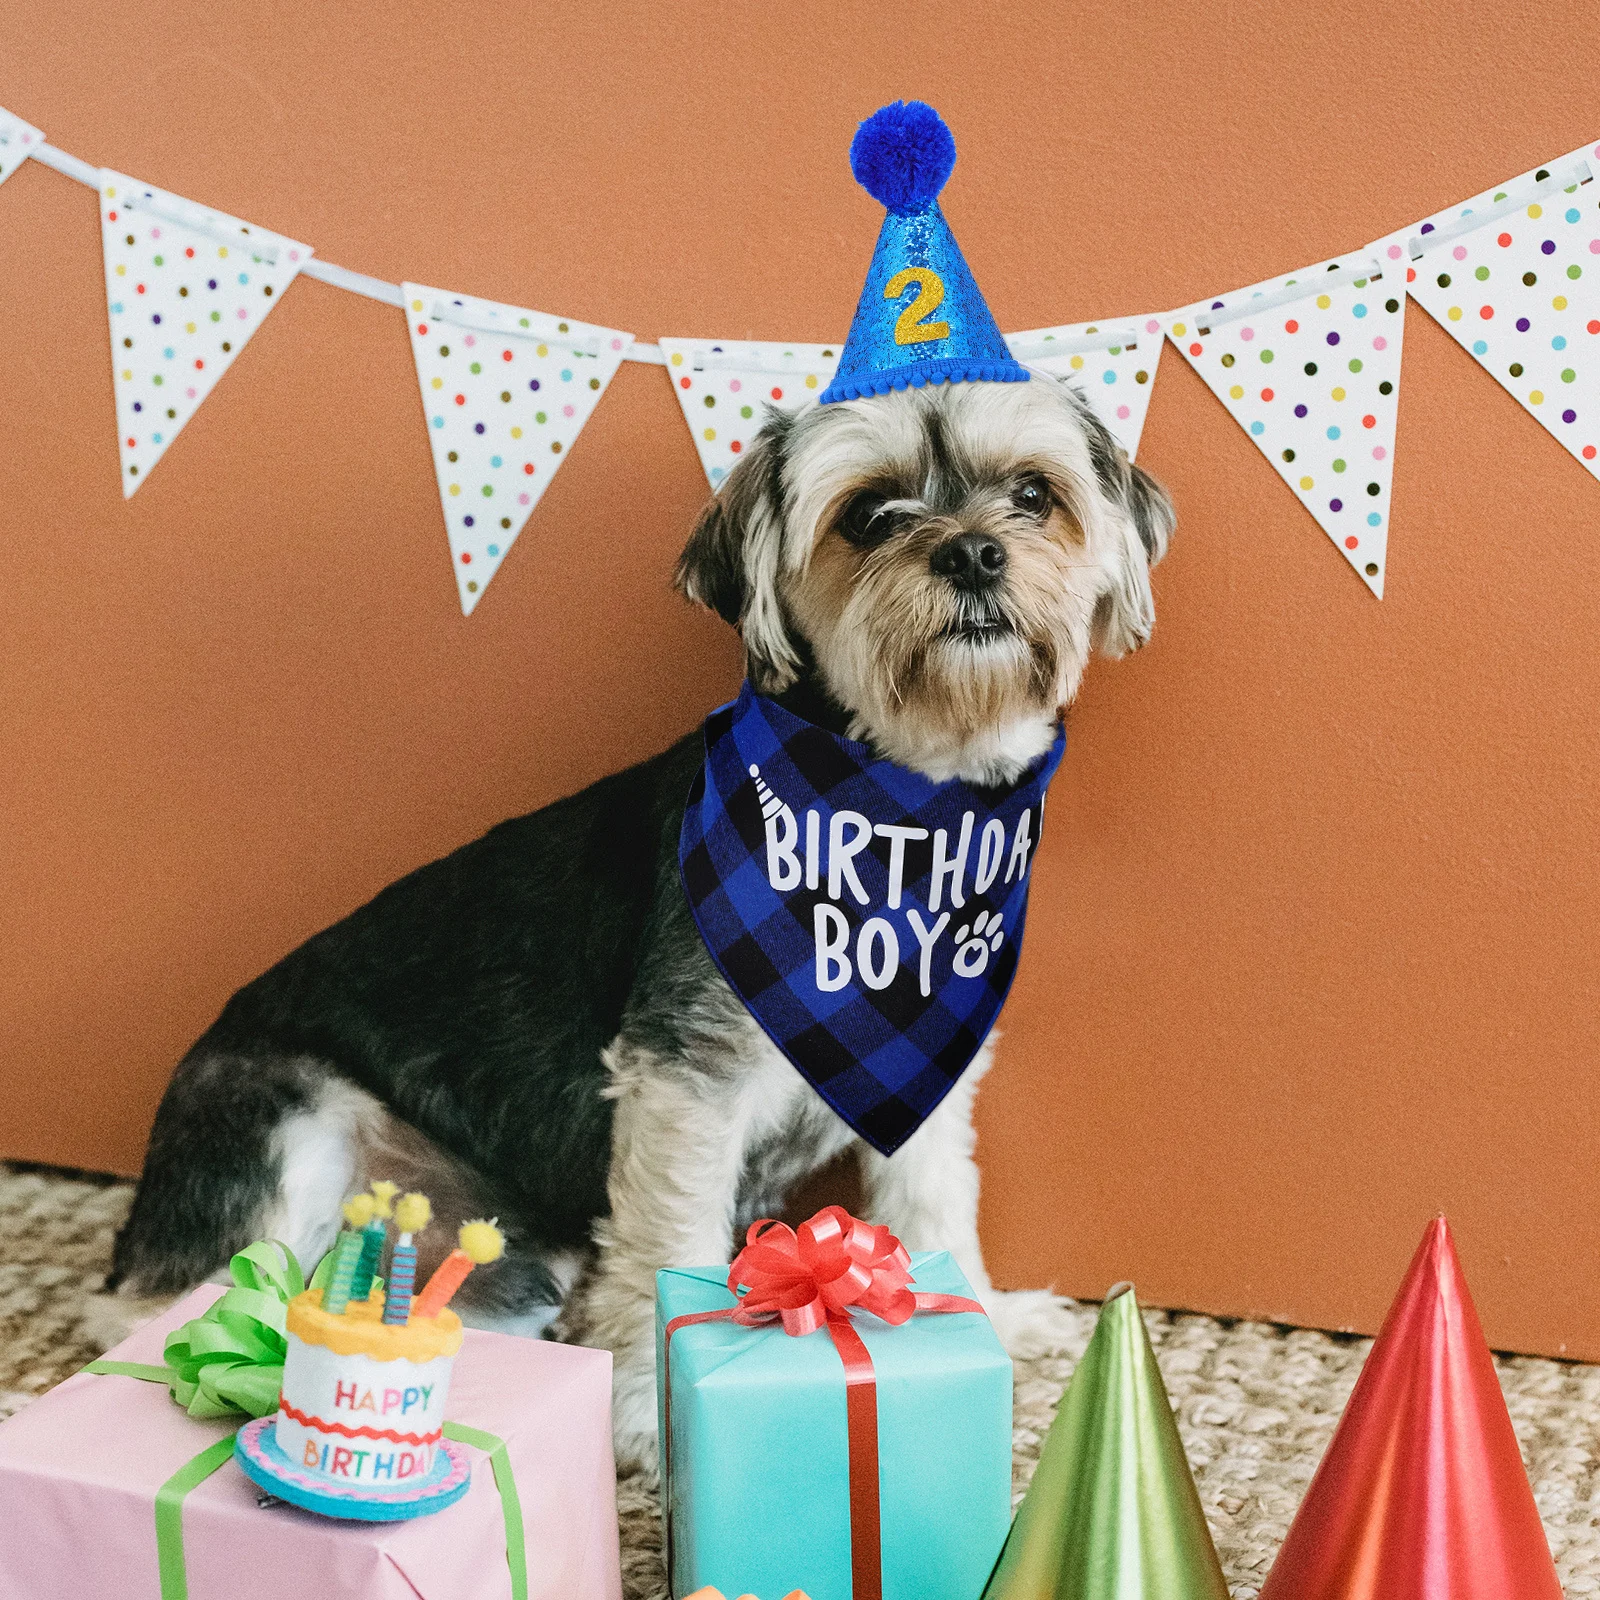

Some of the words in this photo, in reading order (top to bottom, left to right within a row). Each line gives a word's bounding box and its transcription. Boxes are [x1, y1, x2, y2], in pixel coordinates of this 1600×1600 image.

[883, 266, 950, 346] 2
[764, 791, 1046, 911] BIRTHDA
[813, 903, 951, 997] BOY
[334, 1380, 434, 1416] HAPPY
[303, 1439, 432, 1479] BIRTHDA
